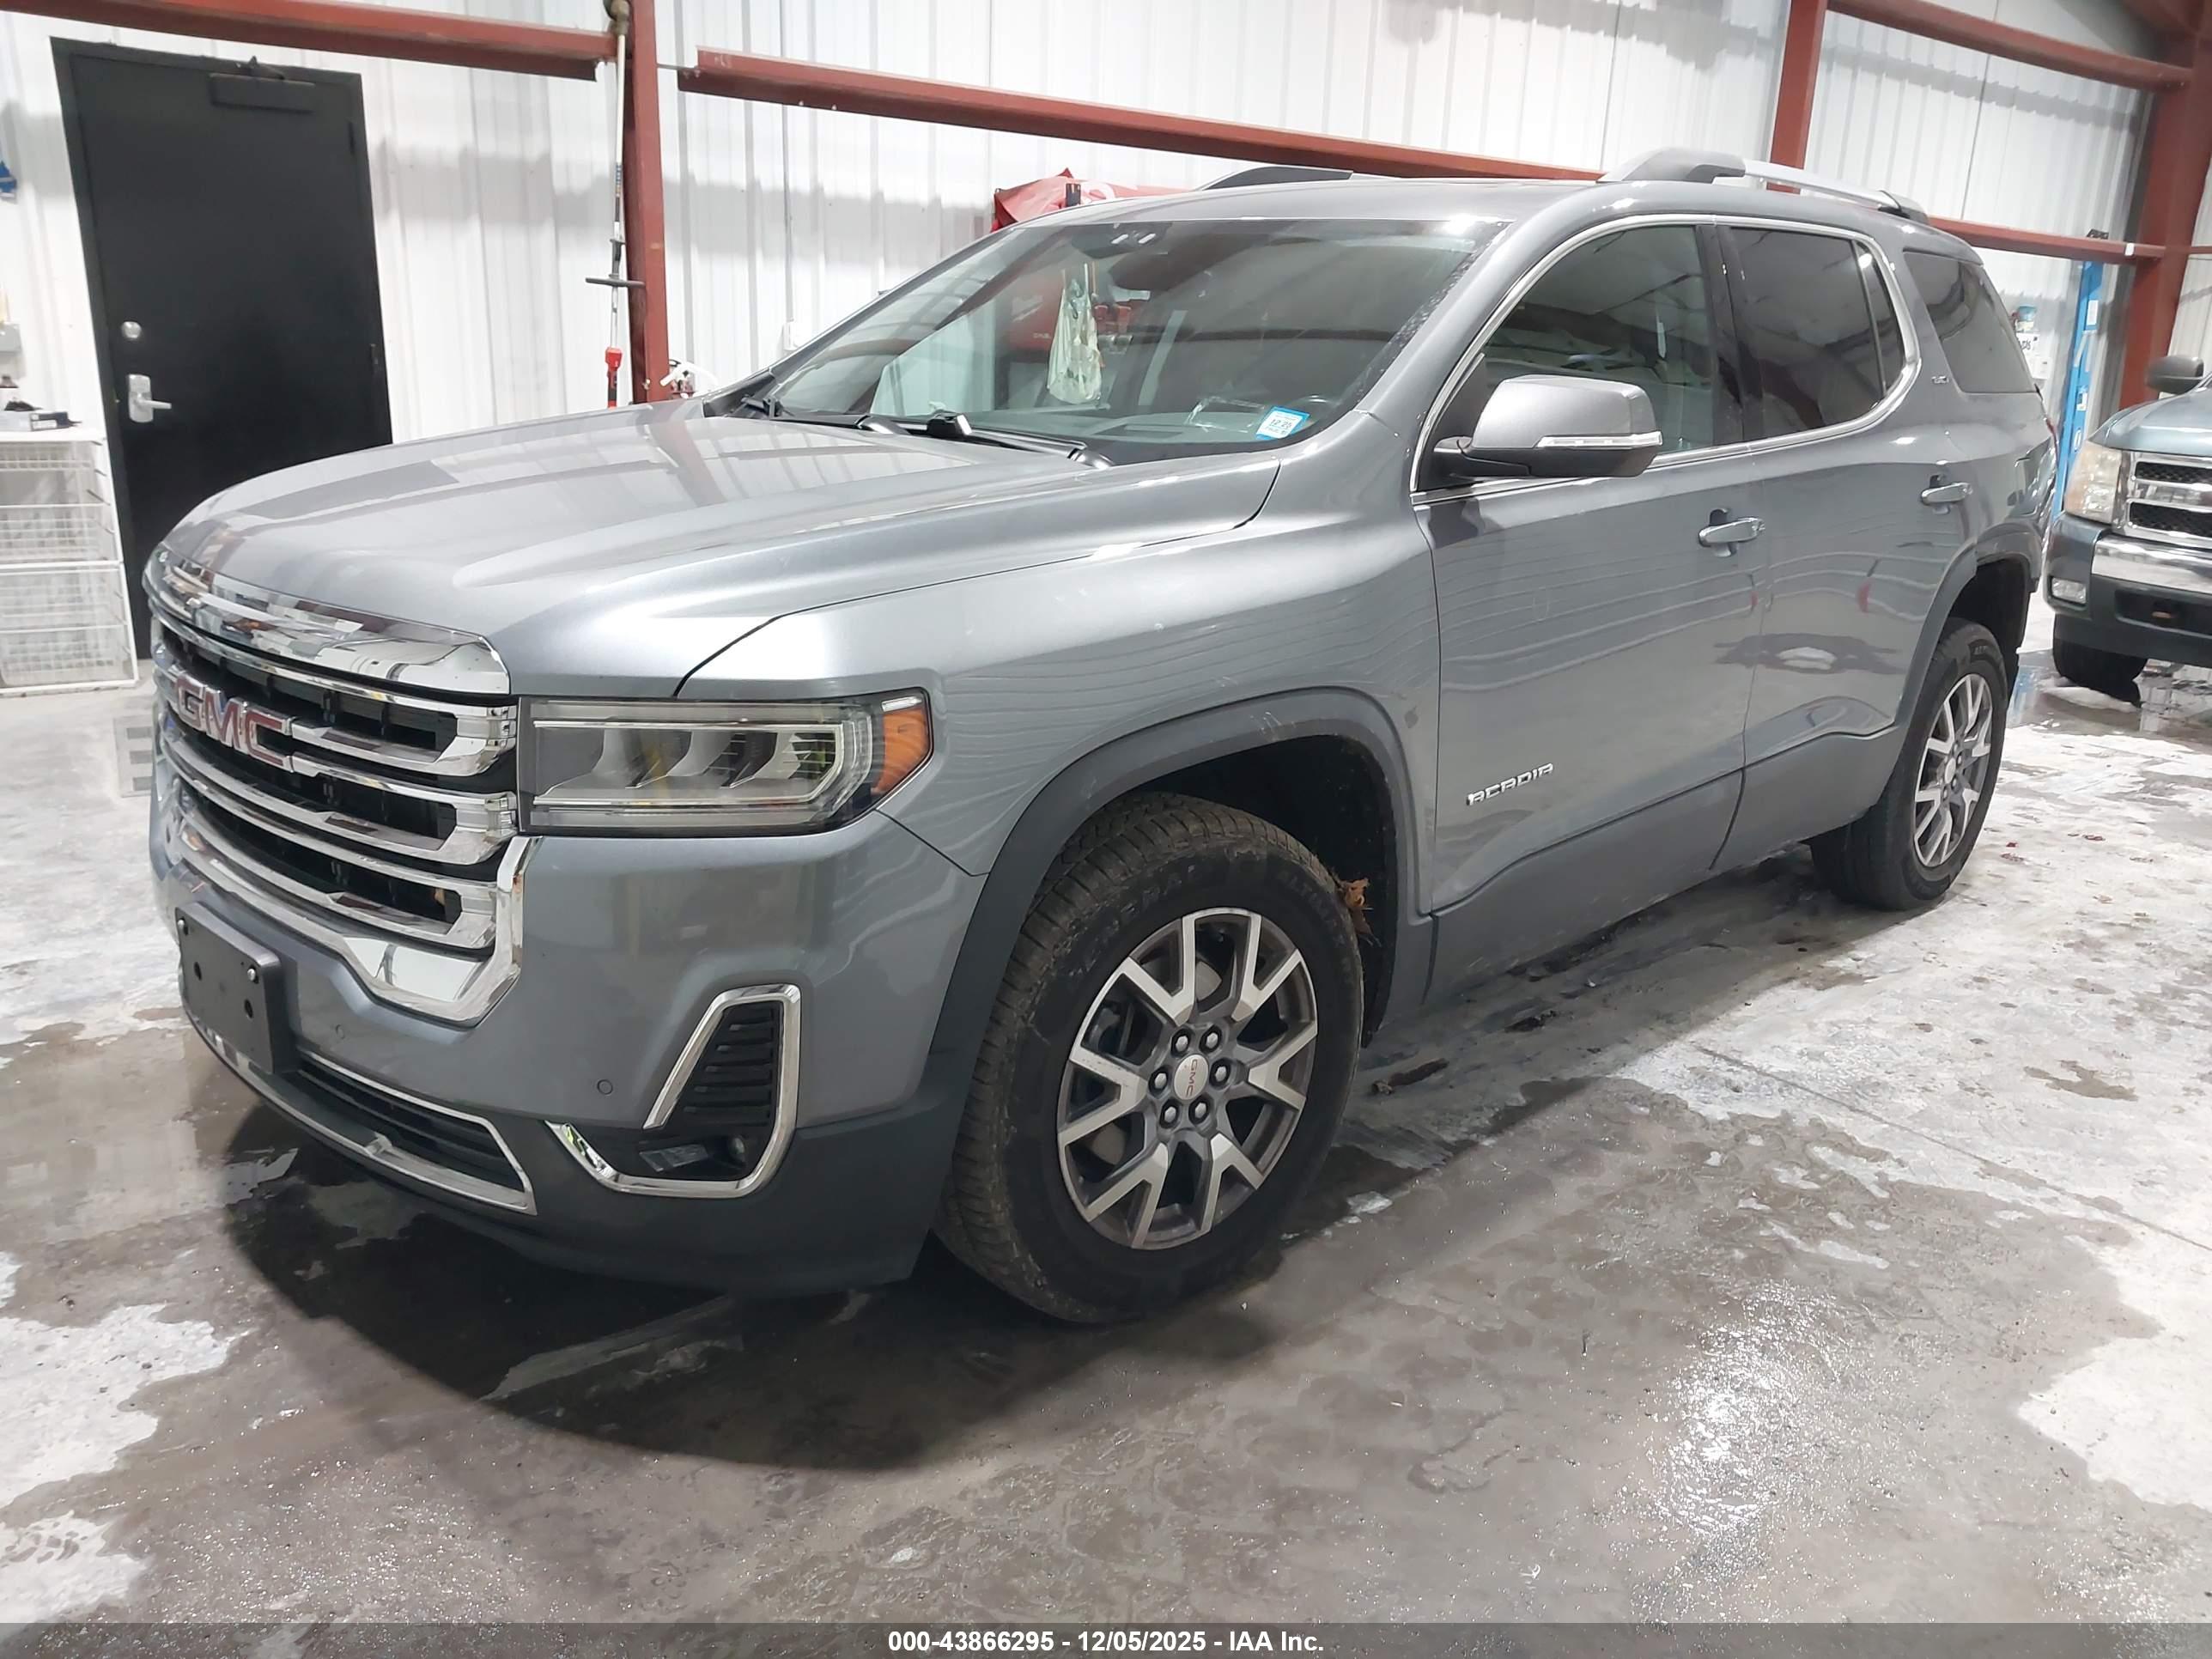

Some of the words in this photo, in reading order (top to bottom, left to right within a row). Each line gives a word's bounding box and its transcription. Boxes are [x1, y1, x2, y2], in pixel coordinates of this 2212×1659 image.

[176, 672, 294, 773] GMC
[1467, 763, 1553, 805] ACADIA
[1185, 1059, 1198, 1098] GMC
